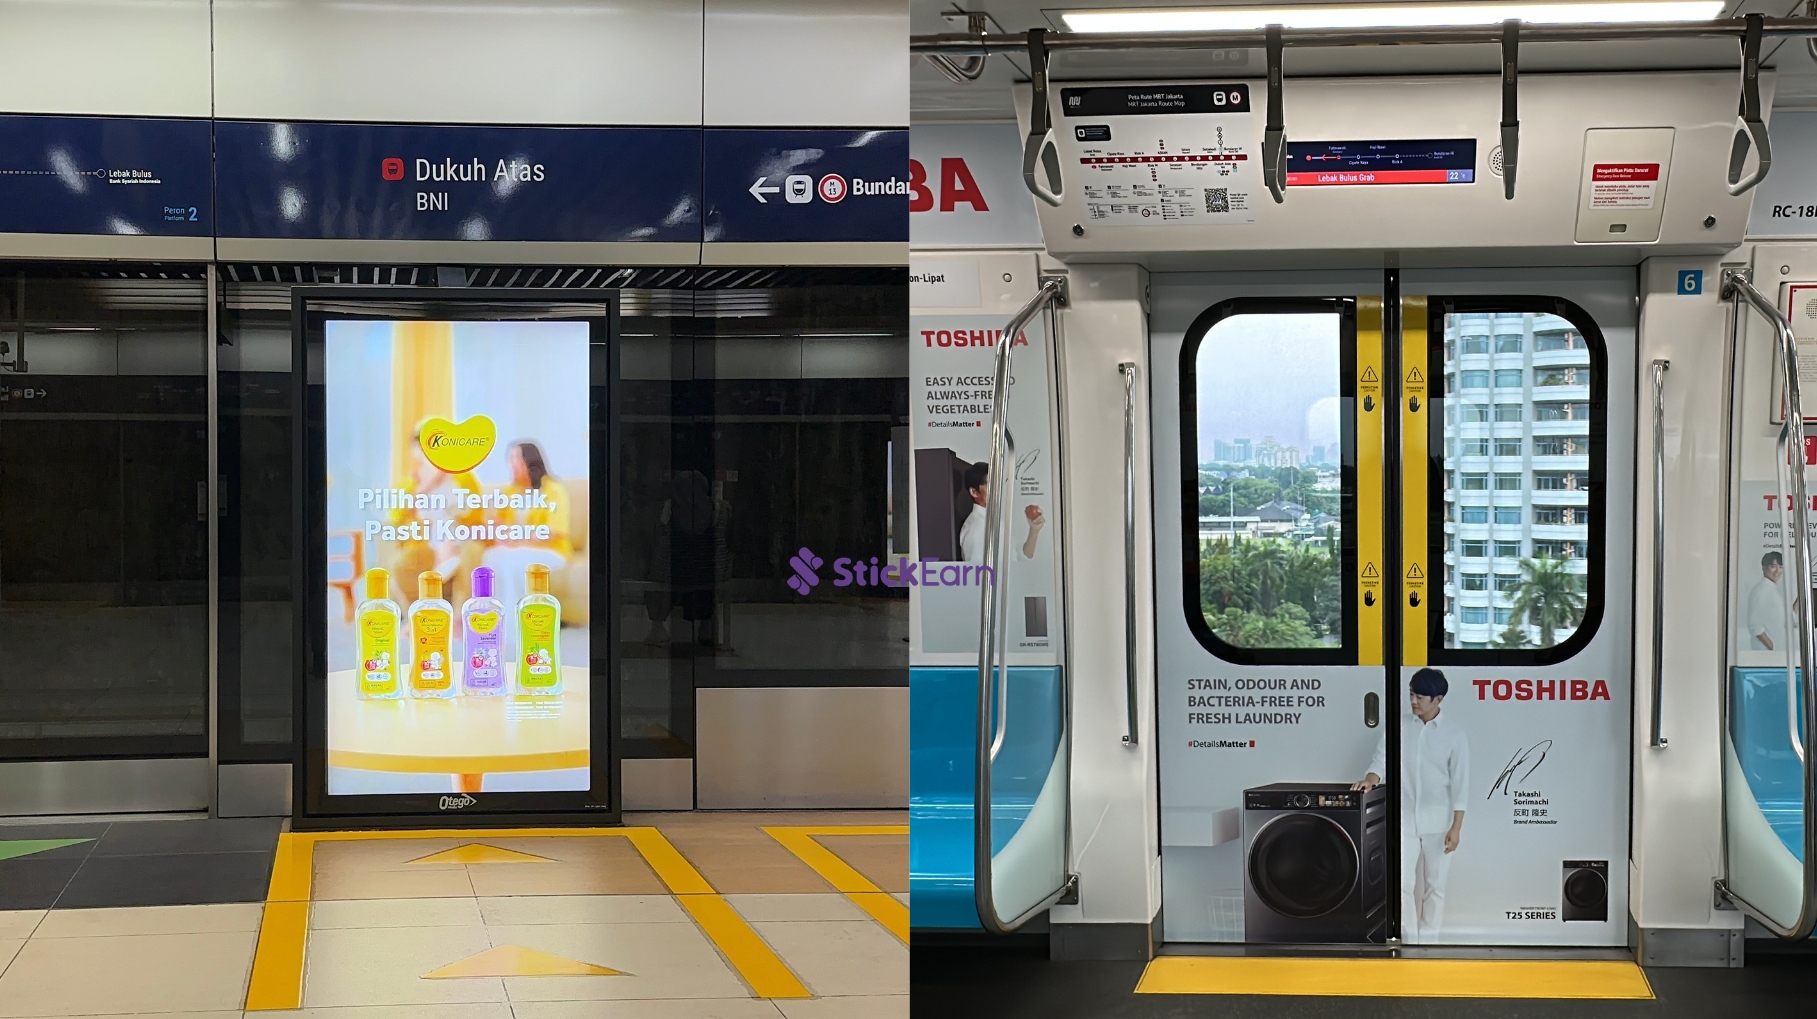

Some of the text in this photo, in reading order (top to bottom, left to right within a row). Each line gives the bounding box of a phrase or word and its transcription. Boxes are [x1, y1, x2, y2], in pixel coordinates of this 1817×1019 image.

[109, 170, 152, 178] Lebak Bulus
[416, 158, 545, 182] Dukuh Atas
[1450, 172, 1459, 180] 22
[1318, 173, 1375, 182] Lebak Bulus Grab
[416, 192, 448, 210] BNI
[188, 206, 198, 221] 2
[1684, 274, 1696, 292] 6
[926, 376, 953, 386] EASY
[926, 390, 992, 400] ALWAYS-FRE
[358, 488, 557, 512] Pilihan Terbaik,
[365, 520, 550, 540] Pasti Konicare
[1188, 678, 1322, 692] STAIN, ODOUR AND
[1472, 680, 1610, 700] TOSHIBA
[1188, 696, 1325, 707] BACTERIA-FREE FOR
[1188, 712, 1302, 724] FRESH LAUNDRY
[1188, 740, 1247, 748] #DetailsMatter
[1506, 912, 1556, 920] T25 SERIES
